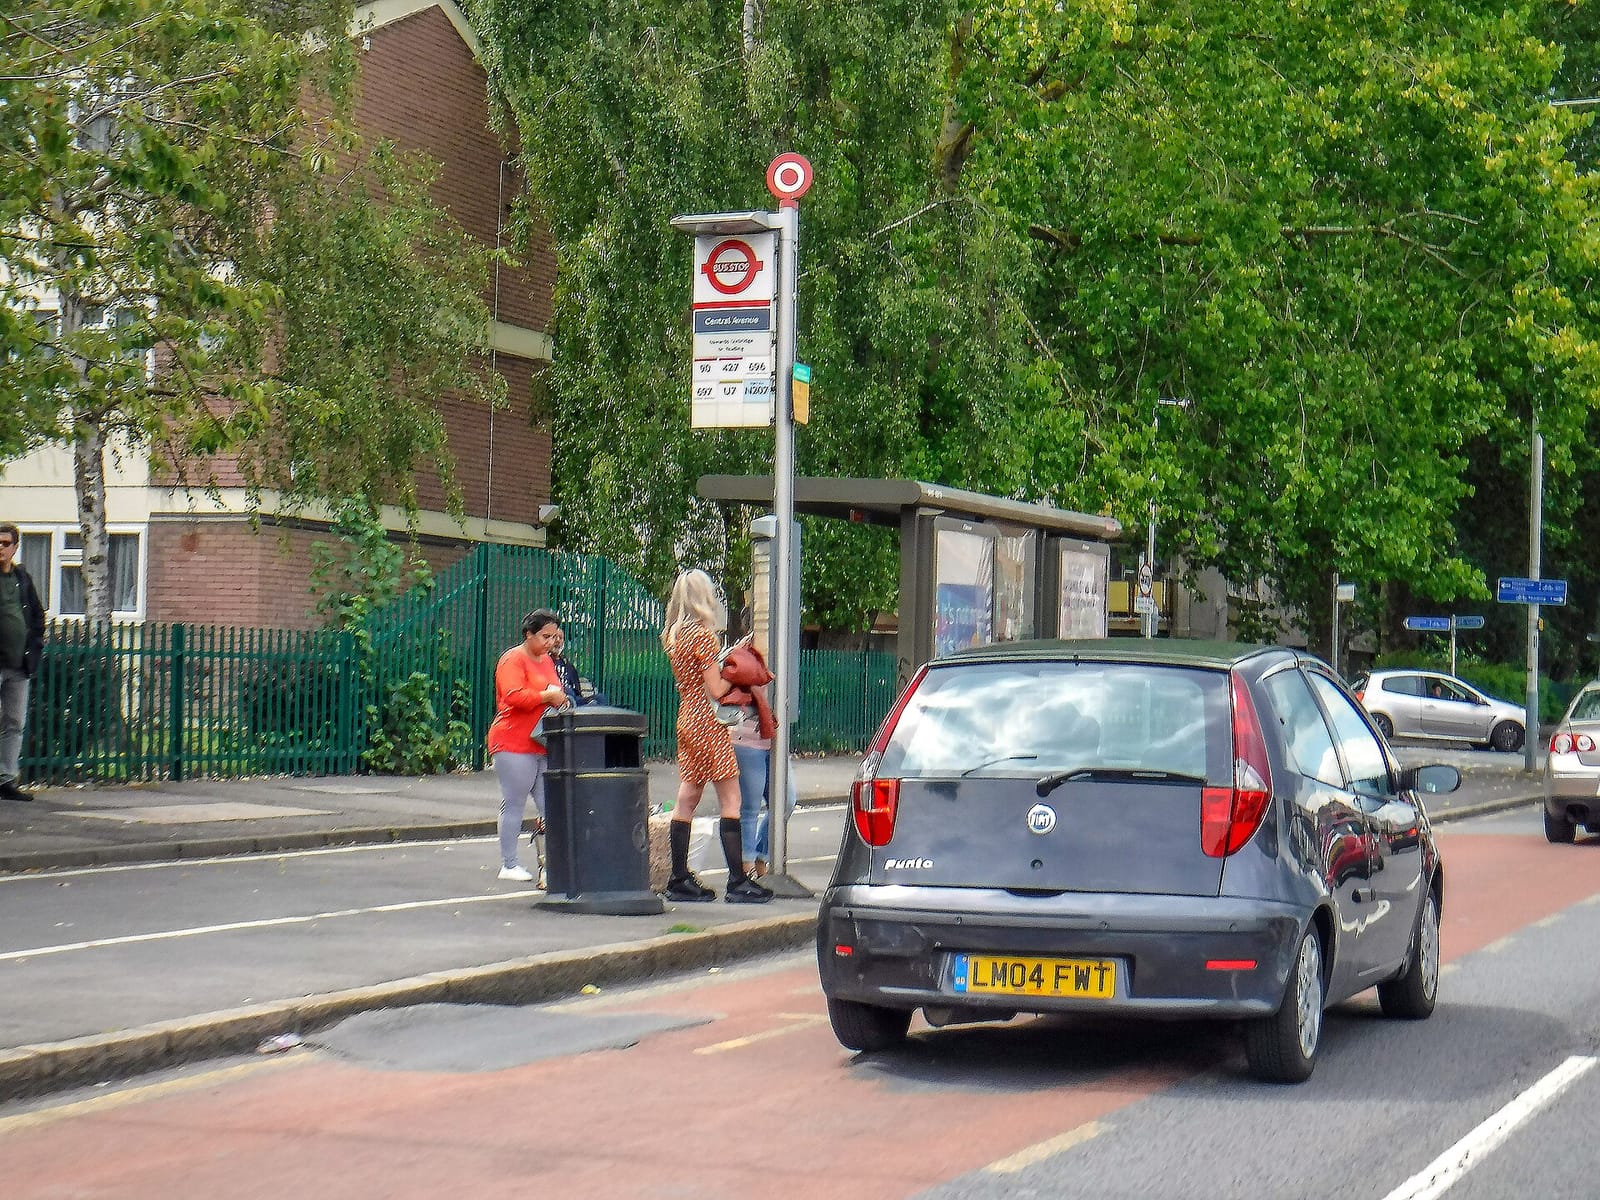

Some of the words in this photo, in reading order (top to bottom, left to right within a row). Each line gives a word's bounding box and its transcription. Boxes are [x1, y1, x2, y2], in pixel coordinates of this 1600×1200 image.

[713, 263, 728, 272] BUS
[729, 262, 750, 272] STOP
[705, 316, 731, 326] Central
[732, 315, 760, 325] Avenue
[722, 363, 739, 372] 427
[723, 386, 737, 396] U7
[744, 386, 769, 396] N207
[973, 961, 1046, 988] LM04
[1054, 963, 1111, 993] FWT
